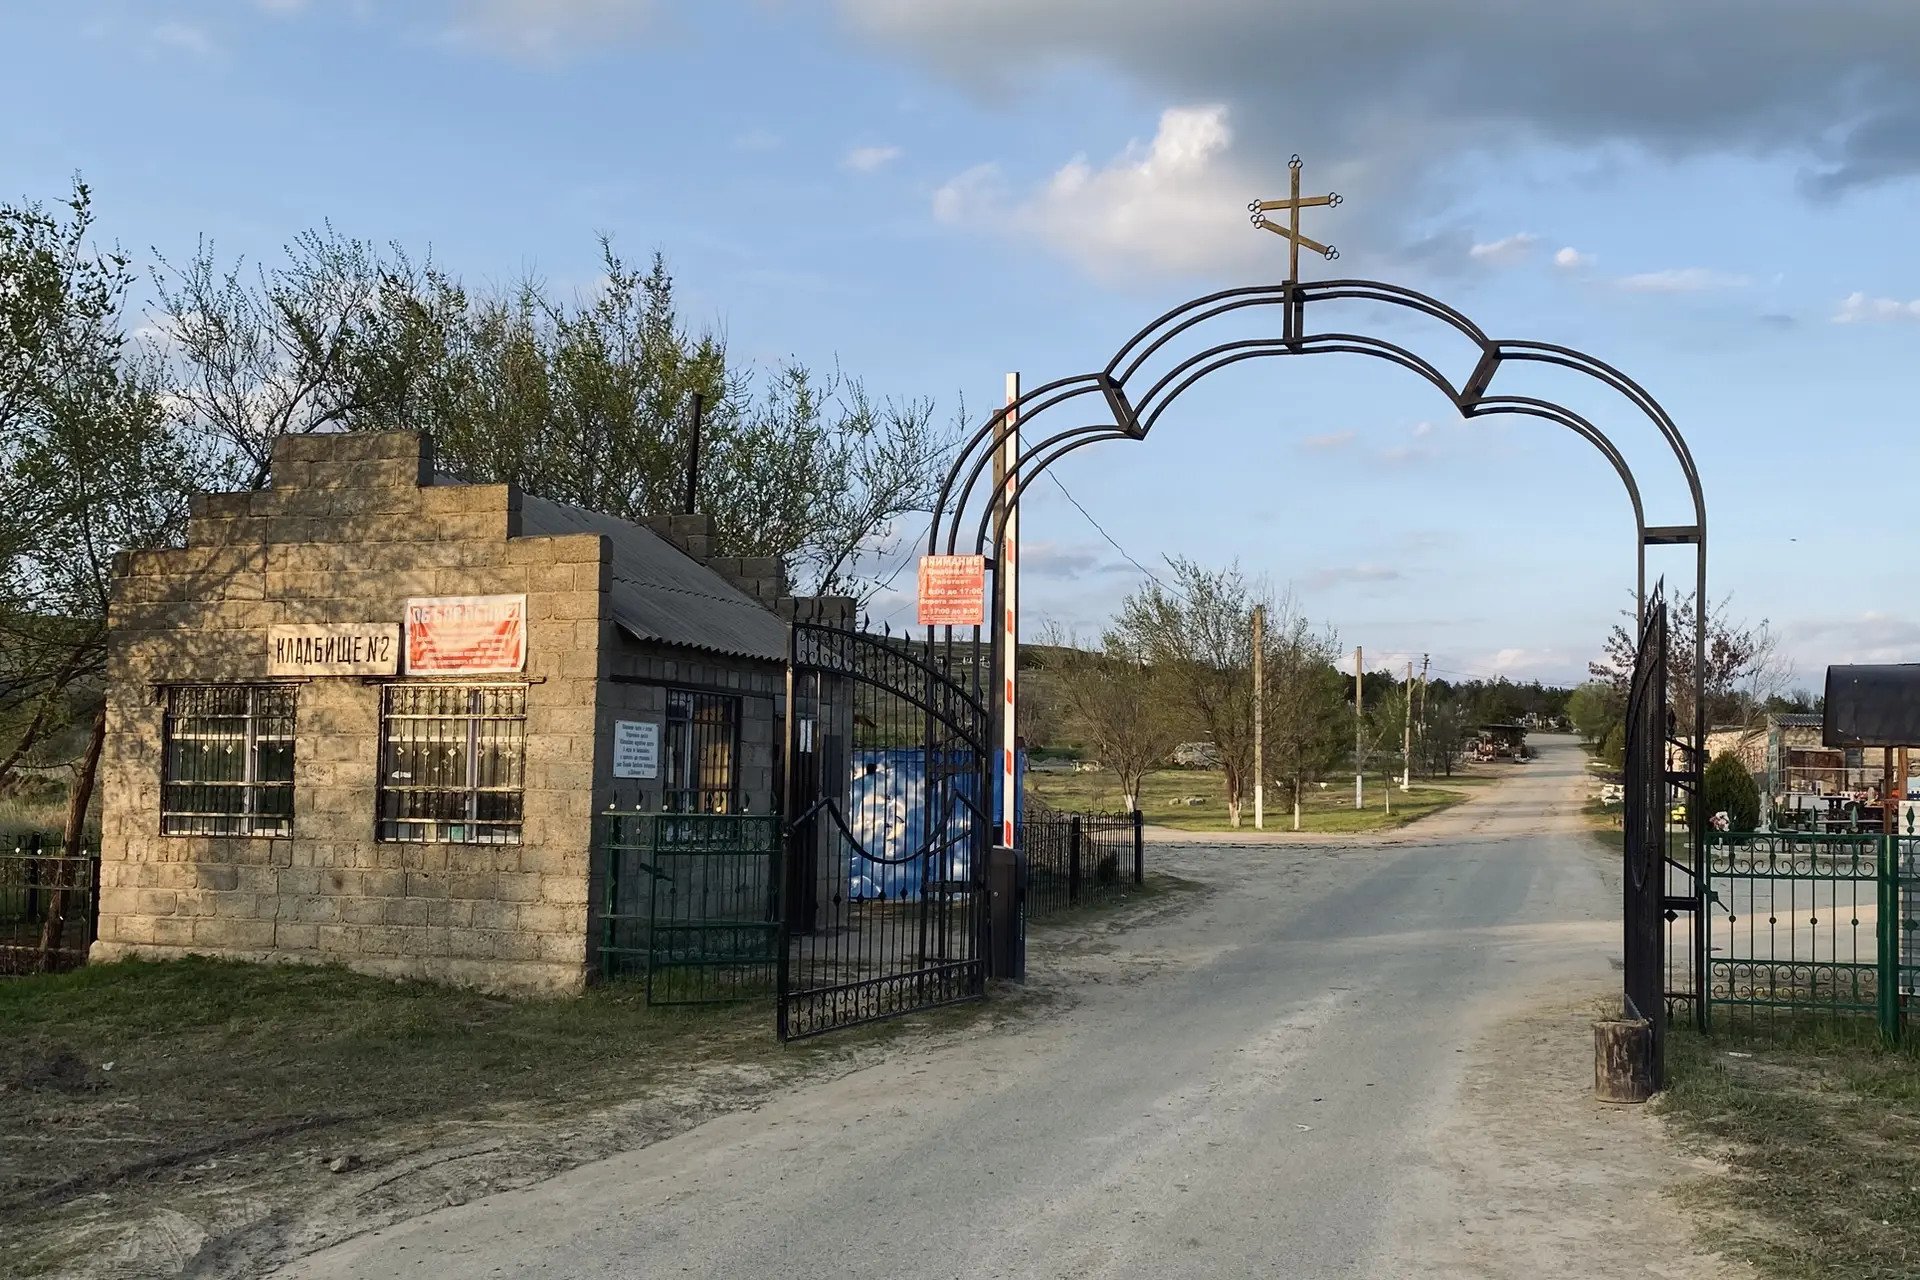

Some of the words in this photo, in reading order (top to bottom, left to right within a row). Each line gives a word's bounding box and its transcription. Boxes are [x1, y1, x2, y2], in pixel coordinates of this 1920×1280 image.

[959, 587, 983, 595] 17:00
[929, 607, 950, 615] 17:00
[276, 636, 362, 665] КЛАДБИЩЕ
